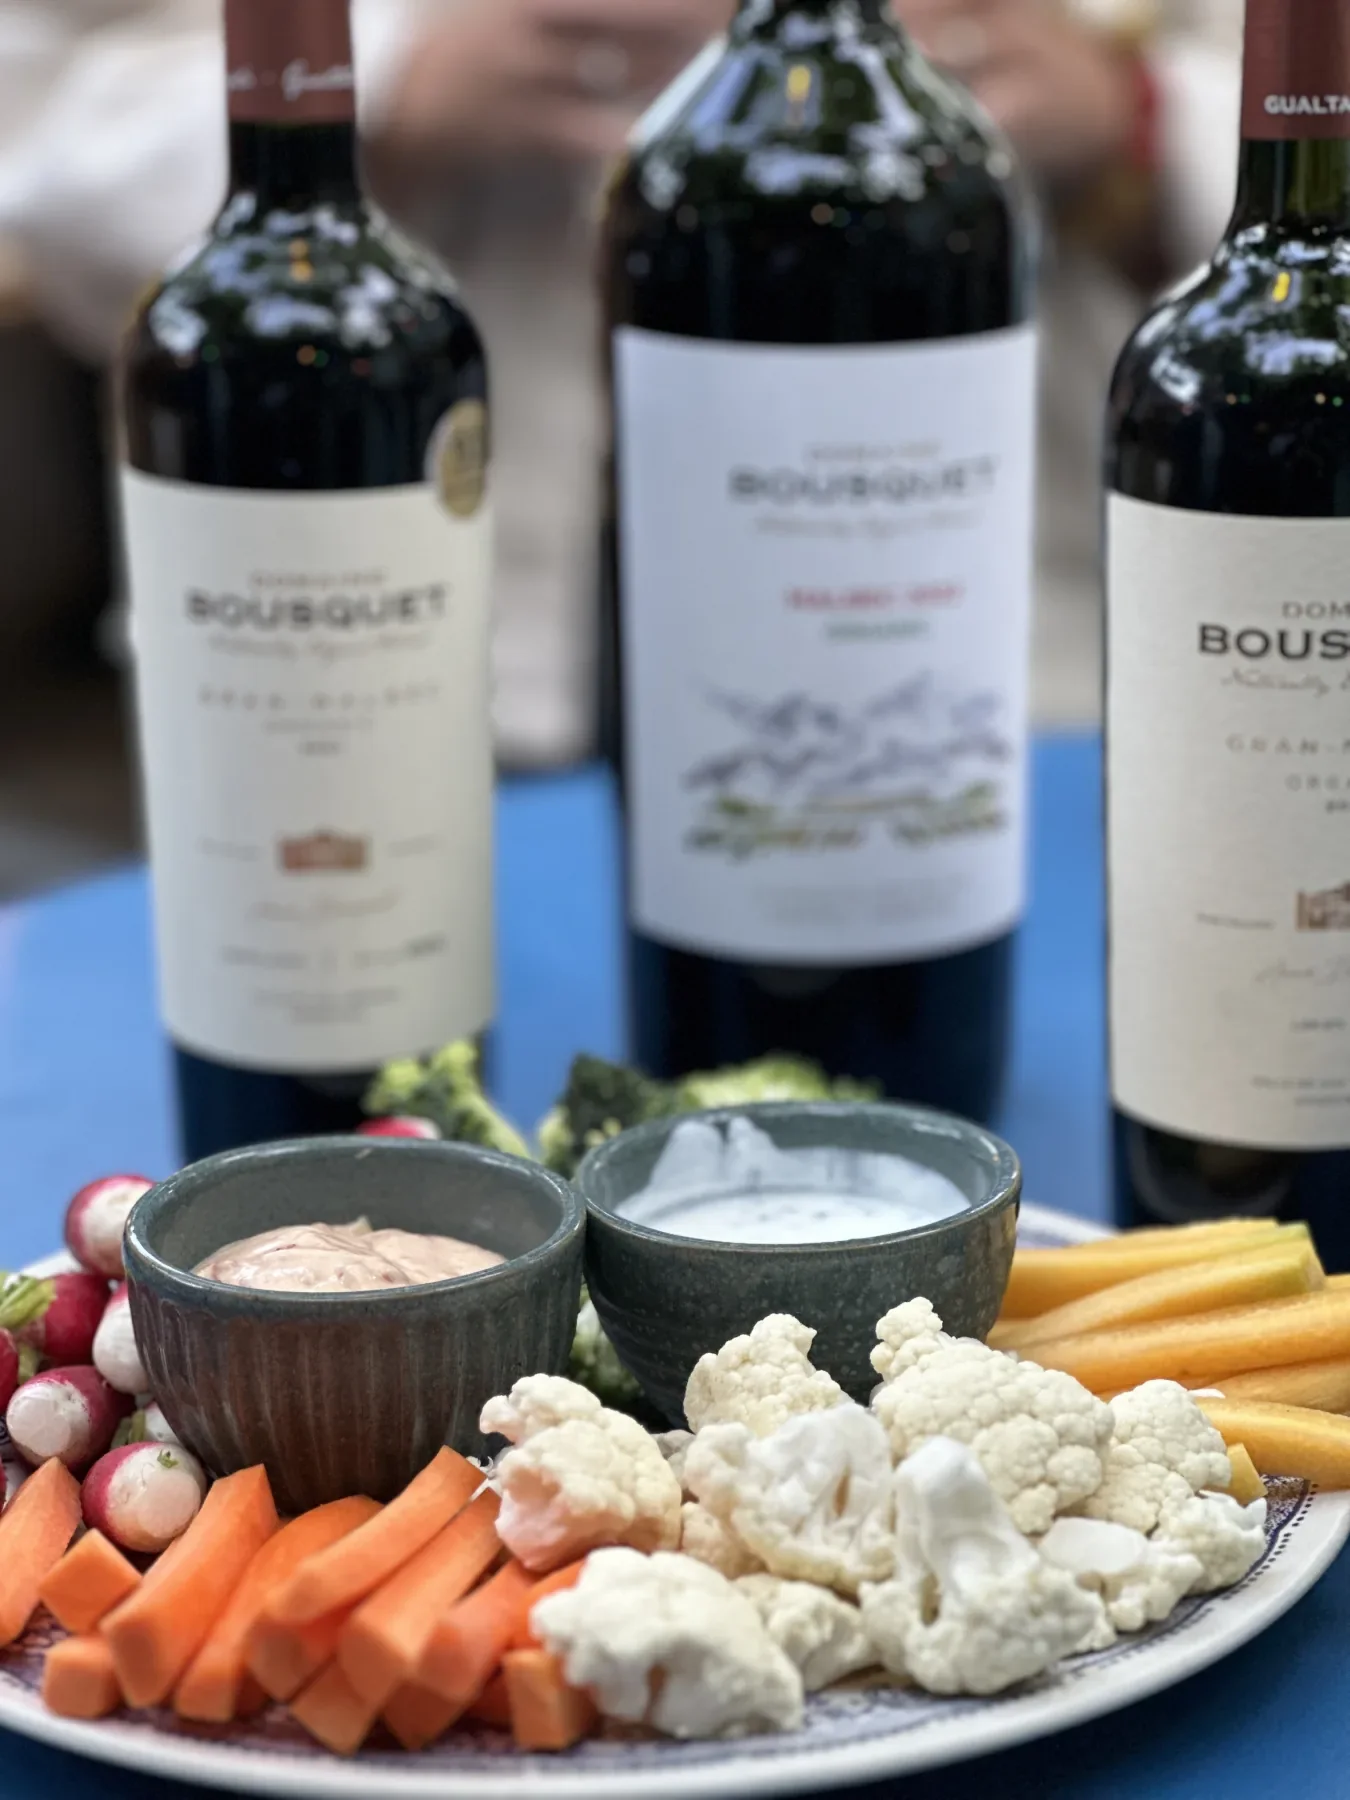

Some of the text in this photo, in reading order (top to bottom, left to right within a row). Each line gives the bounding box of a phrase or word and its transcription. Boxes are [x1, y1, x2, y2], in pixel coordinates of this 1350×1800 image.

[1263, 94, 1350, 115] GUALTA
[186, 586, 448, 630] BOUSQUET
[1198, 622, 1350, 661] BOUS
